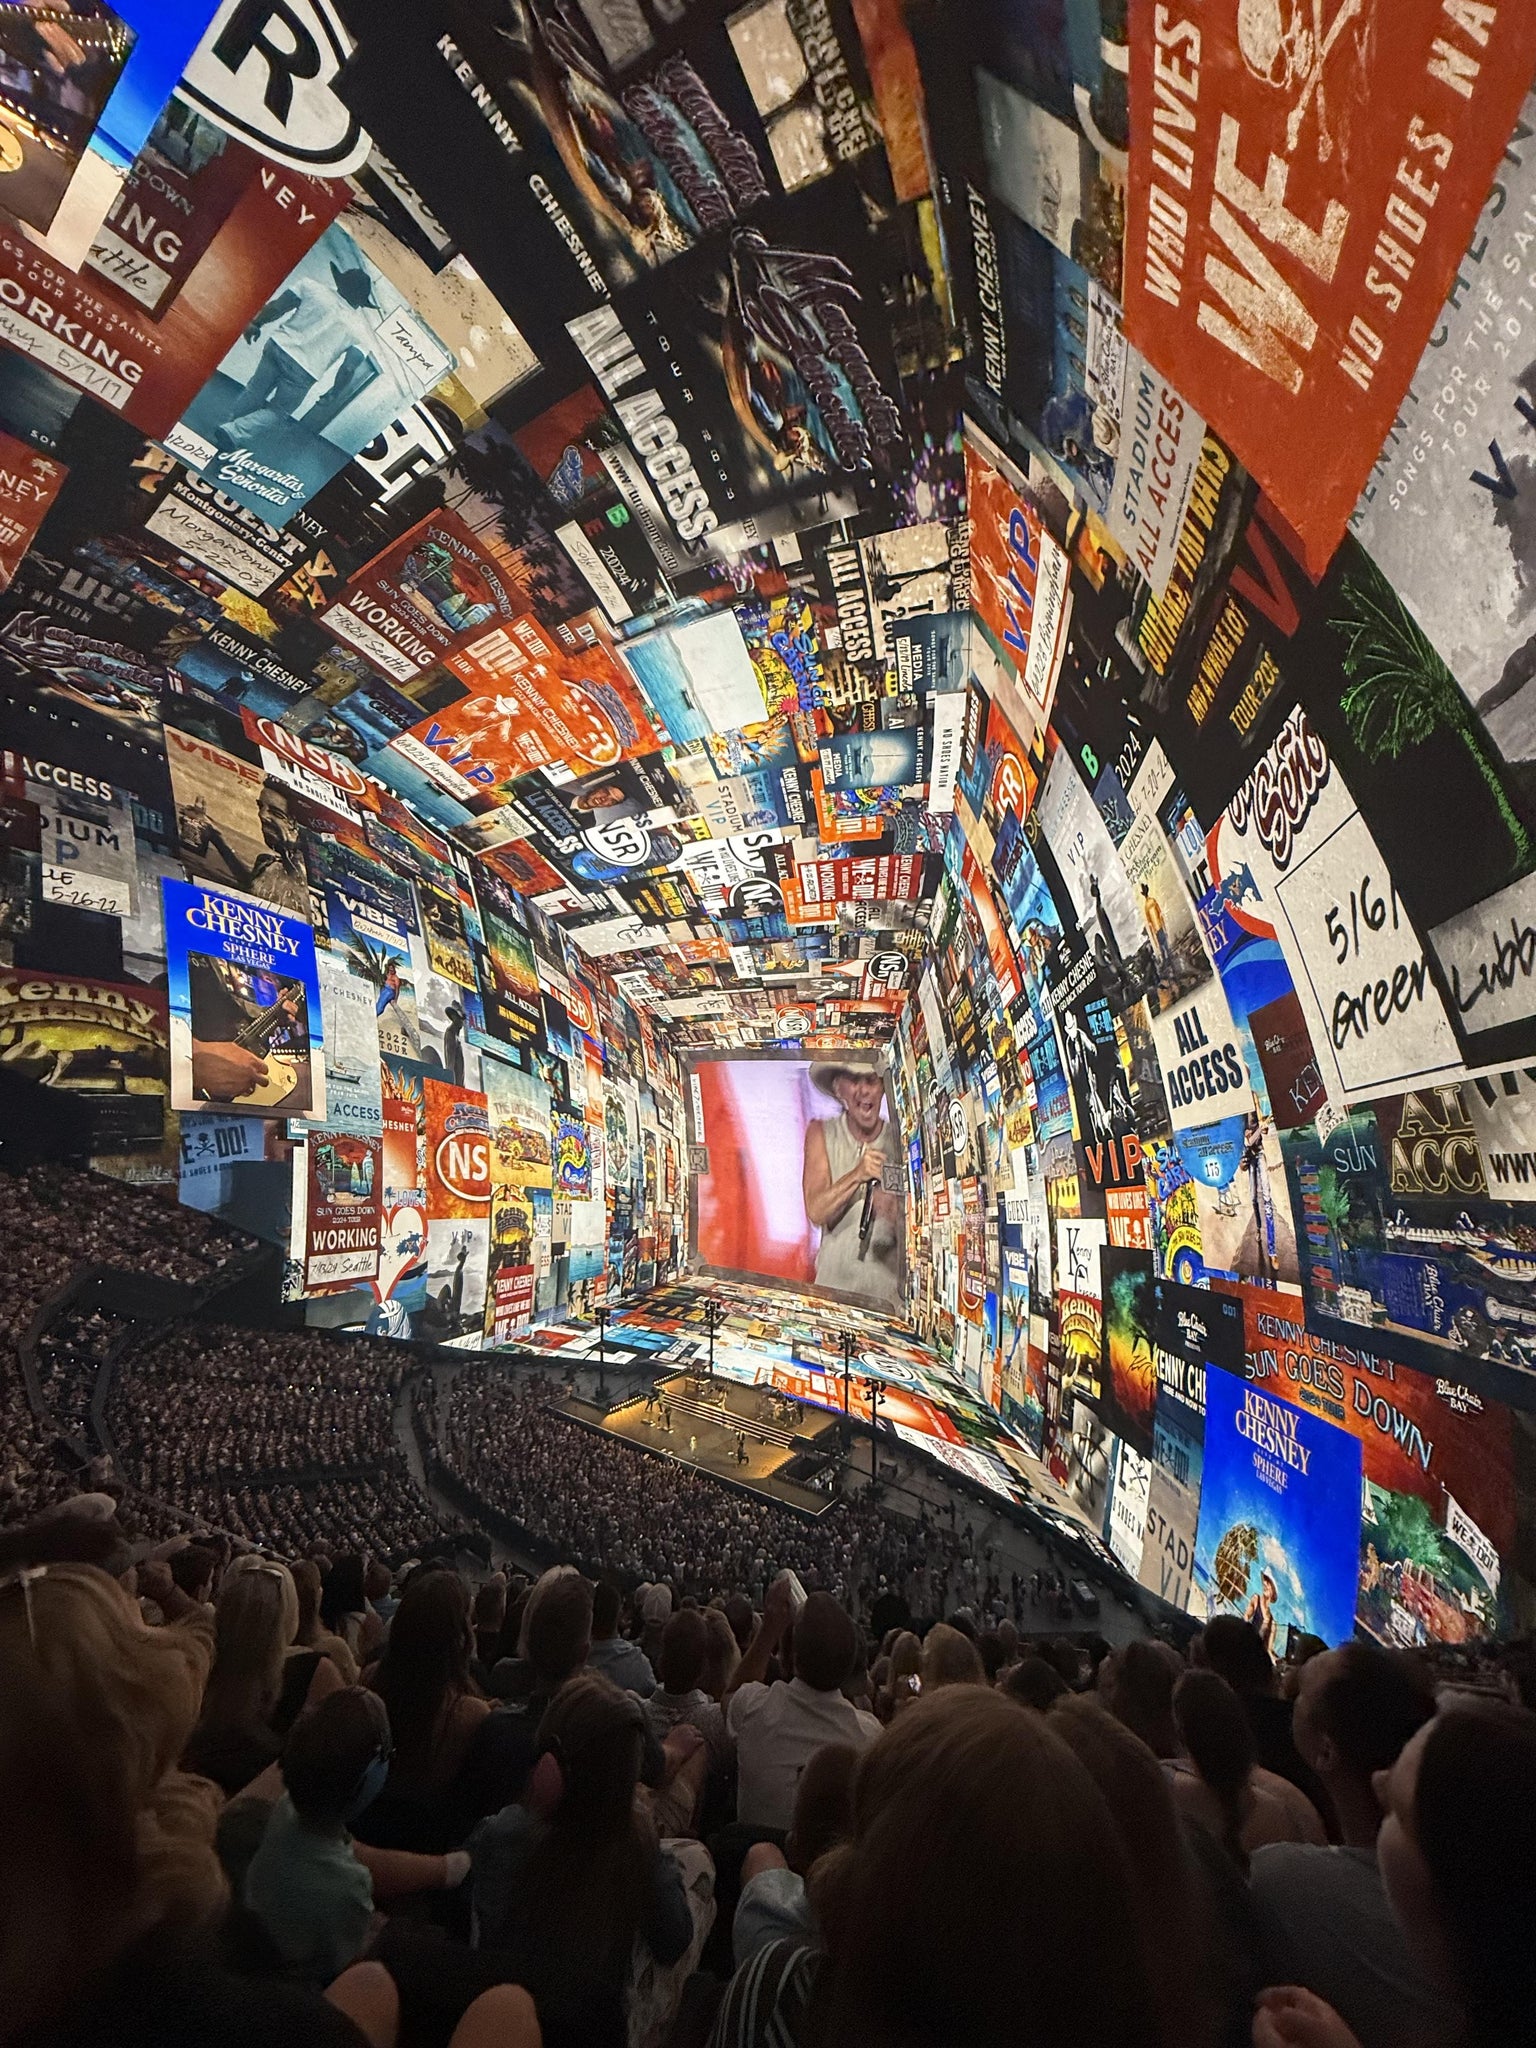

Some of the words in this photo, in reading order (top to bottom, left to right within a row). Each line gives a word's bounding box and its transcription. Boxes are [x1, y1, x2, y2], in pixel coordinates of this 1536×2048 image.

[436, 32, 524, 154] KENNY
[1151, 2, 1201, 191] LIVES
[966, 179, 999, 311] CHESNEY
[1144, 182, 1189, 309] WHO
[1196, 112, 1350, 395] WE
[1337, 315, 1385, 392] NO
[1364, 113, 1455, 313] SHOES
[16, 262, 64, 298] TOUR
[74, 303, 113, 332] 2019
[32, 260, 65, 287] FOR
[74, 288, 104, 312] THE
[110, 314, 163, 355] SAINTS
[391, 321, 435, 371] Tampa
[985, 309, 1003, 398] KENNY
[1388, 430, 1434, 512] SONGS
[1432, 364, 1468, 425] FOR
[1463, 289, 1504, 352] THE
[1441, 376, 1493, 457] TOUR
[563, 304, 647, 400] ALL
[613, 388, 719, 541] ACCESS
[1123, 370, 1156, 528] STADIUM
[1147, 388, 1185, 516] ACCES
[218, 449, 304, 492] Margaritas
[218, 465, 289, 506] Señoritas
[158, 506, 278, 579] Morgantown
[174, 482, 293, 569] Montgomery-Gentry
[826, 548, 859, 588] ALL
[1135, 521, 1162, 579] ALL
[427, 525, 482, 564] KENNY
[479, 564, 514, 621] CHESNEY
[1002, 507, 1037, 653] VIP
[349, 590, 436, 666] WORKING
[376, 579, 401, 600] SUN
[399, 597, 428, 626] GOES
[426, 622, 452, 647] DOWN
[408, 617, 428, 637] TOUR
[836, 587, 877, 662] ACCESS
[209, 630, 254, 662] KENNY
[254, 654, 312, 696] CHESNEY
[365, 641, 411, 675] Seattle
[450, 654, 475, 676] TION
[794, 632, 819, 683] SUN
[913, 644, 923, 682] MEDIA
[1209, 624, 1240, 689] WHOLE
[1230, 601, 1250, 649] LOT
[7, 698, 79, 728] TOUR
[1228, 679, 1258, 736] TOUR
[424, 722, 495, 786] VIP
[941, 740, 952, 764] SHOES
[943, 728, 953, 739] NO
[168, 730, 262, 787] VIBE
[273, 721, 353, 789] NSR
[832, 752, 843, 779] MEDIA
[916, 750, 924, 783] CHESNEY
[1081, 744, 1099, 779] B
[1115, 730, 1142, 789] 2024
[783, 767, 798, 791] KENNY
[938, 764, 950, 788] NATION
[539, 802, 575, 837] ACCESS
[706, 799, 727, 825] VIP
[717, 785, 744, 833] STADIUM
[790, 791, 806, 824] CHESNEY
[901, 855, 913, 875] KENNY
[1066, 831, 1086, 867] VIP
[819, 863, 836, 902] WORKING
[852, 883, 875, 900] DO!
[900, 875, 913, 900] CHESNEY
[200, 893, 285, 935] KENNY
[335, 890, 399, 932] VIBE
[854, 901, 868, 929] ACCESS
[869, 902, 881, 921] ALL
[186, 908, 300, 957] CHESNEY
[223, 941, 276, 965] SPHERE
[230, 953, 247, 964] LAS
[246, 957, 271, 970] VEGAS
[333, 987, 374, 1006] CHESNEY
[1051, 972, 1071, 1010] KENNY
[378, 1032, 407, 1046] 2022
[380, 1041, 408, 1056] TOUR
[1172, 1005, 1210, 1057] ALL
[1166, 1042, 1244, 1109] ACCESS
[333, 1102, 381, 1121] ACCESS
[214, 1125, 249, 1159] DO!
[449, 1140, 488, 1181] NS
[1084, 1133, 1142, 1184] VIP
[1333, 1144, 1378, 1174] SUN
[1204, 1160, 1220, 1178] 175
[316, 1206, 334, 1217] SUN
[333, 1207, 355, 1217] GOES
[356, 1205, 375, 1215] DOWN
[1006, 1198, 1029, 1222] GUEST
[312, 1227, 377, 1251] WORKING
[1110, 1216, 1131, 1249] WE
[342, 1256, 374, 1271] Seattle
[1005, 1250, 1025, 1268] VIBE
[1256, 1313, 1305, 1349] KENNY
[1153, 1347, 1188, 1399] KENNY
[1244, 1387, 1300, 1439] KENNY
[1245, 1350, 1279, 1380] SUN
[1285, 1351, 1345, 1399] GOES
[1352, 1376, 1436, 1471] DOWN
[1434, 1377, 1458, 1401] Blue
[1456, 1383, 1483, 1411] Chair
[1449, 1398, 1469, 1414] BAY
[1234, 1409, 1312, 1477] CHESNEY
[1252, 1451, 1289, 1490] SPHERE
